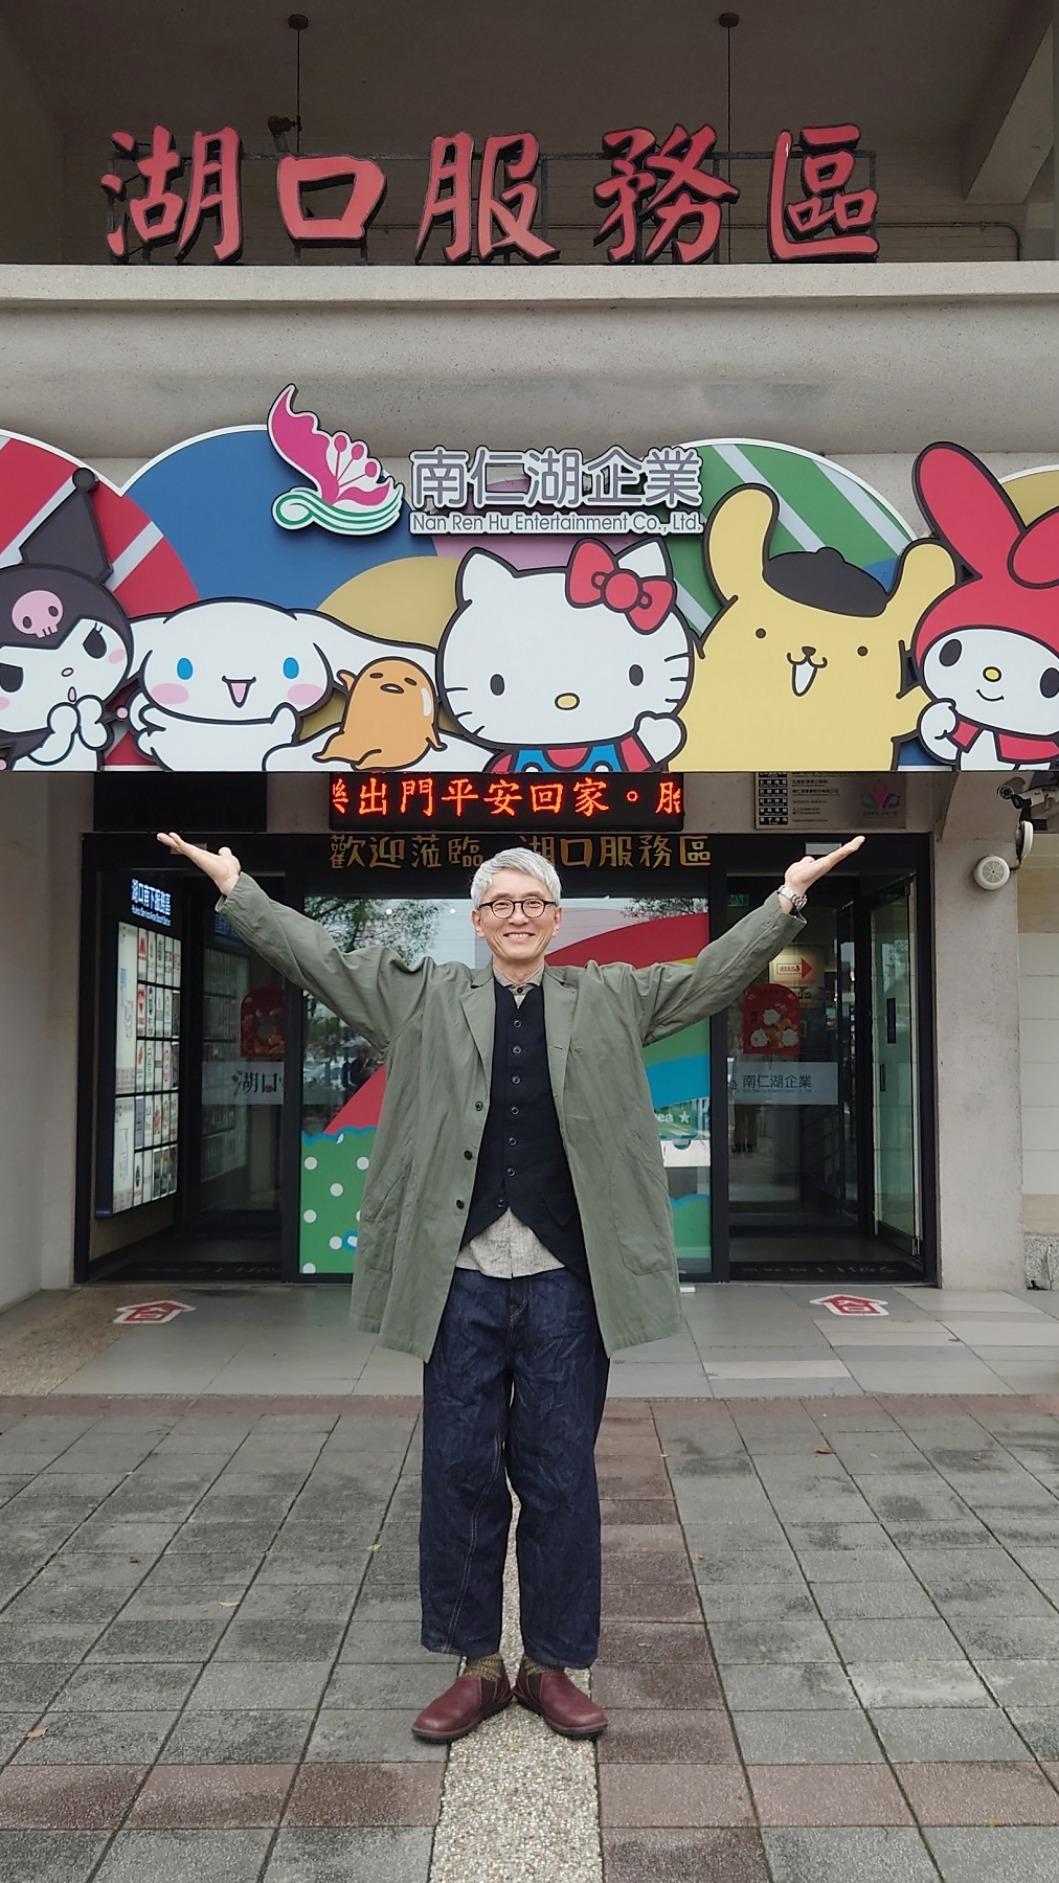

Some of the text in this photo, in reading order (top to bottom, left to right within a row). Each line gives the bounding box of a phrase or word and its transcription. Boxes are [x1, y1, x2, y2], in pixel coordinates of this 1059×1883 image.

[101, 124, 880, 264] 湖口服務區
[411, 446, 702, 507] 南仁湖企業
[413, 514, 702, 534] Nan Ren Hu Entertainment Co., Ltd.
[330, 834, 711, 869] 歡迎蒞臨 湖口服務區
[232, 1069, 282, 1096] 湖口
[742, 1074, 812, 1089] 南仁湖企業
